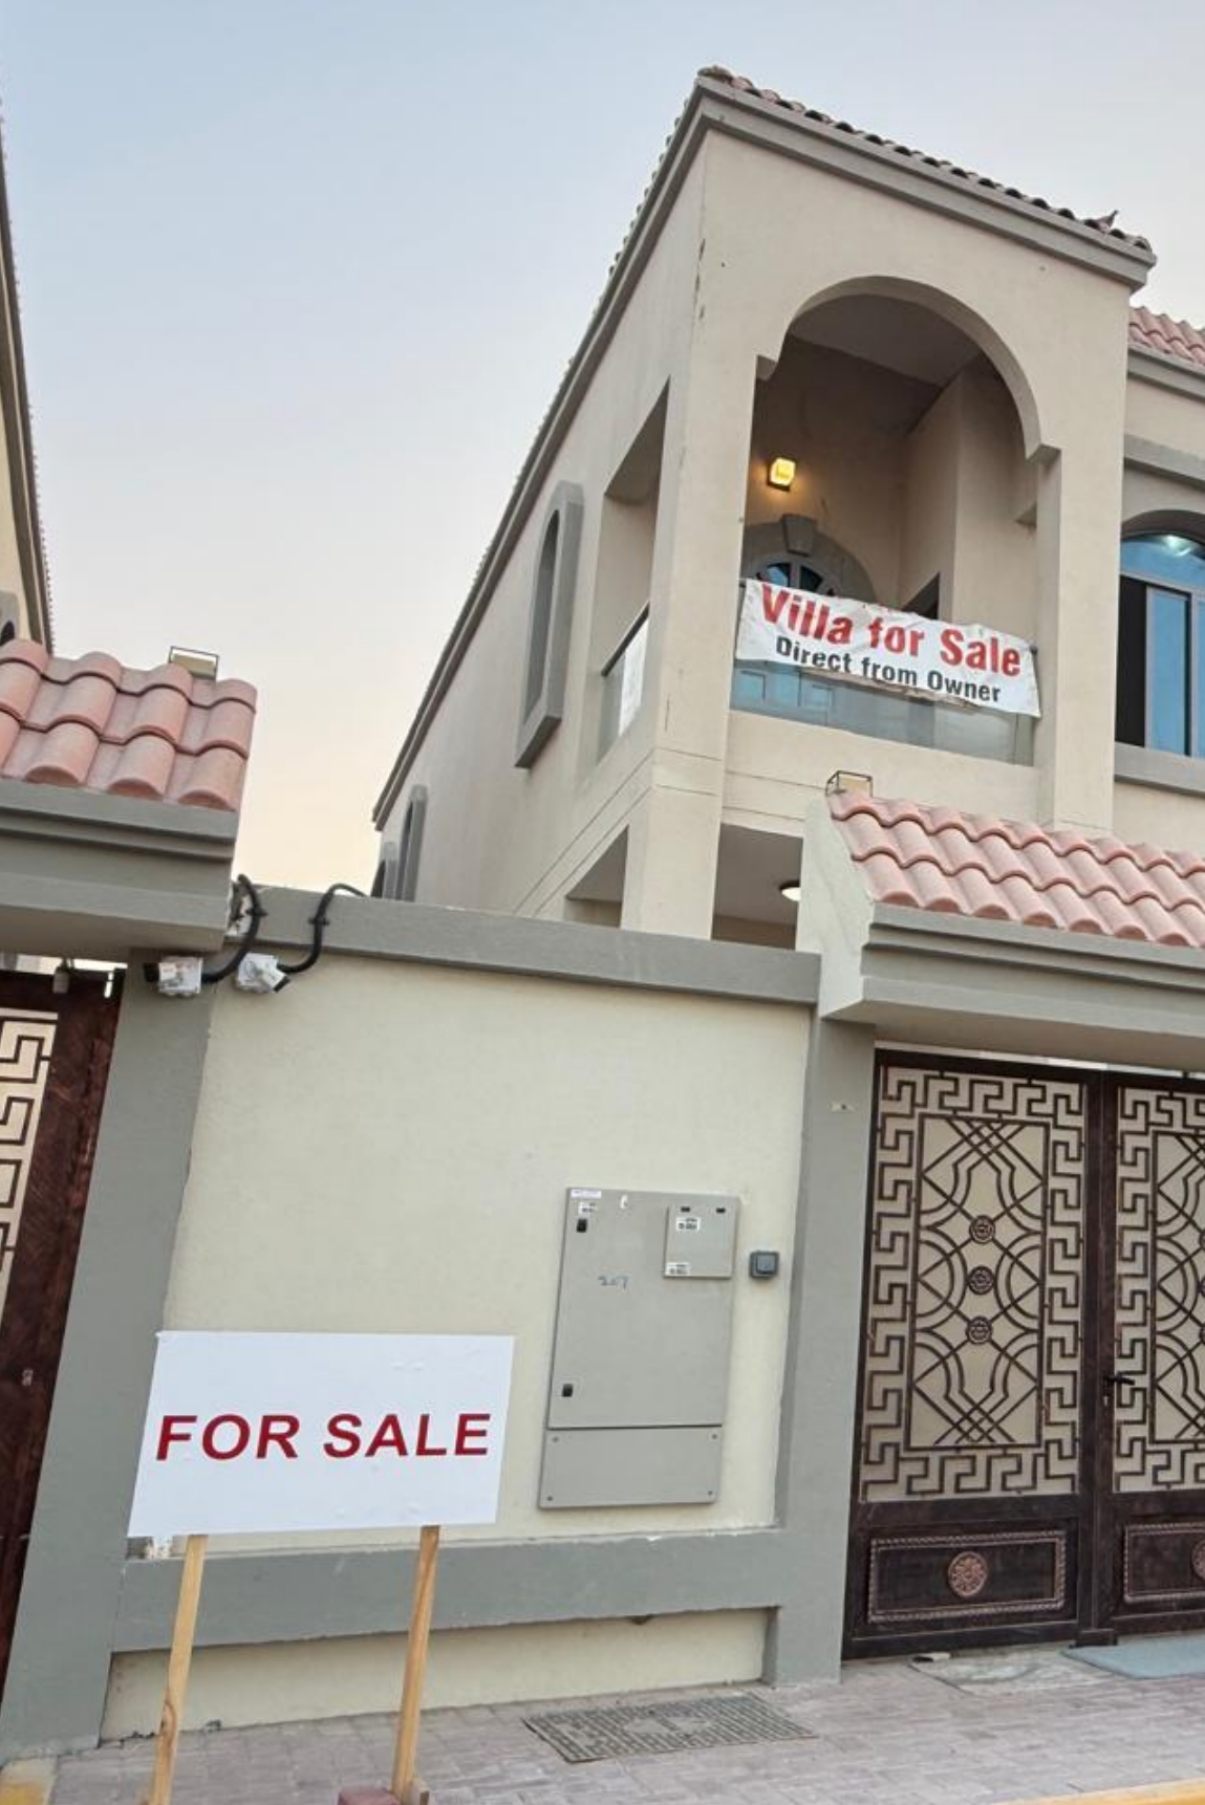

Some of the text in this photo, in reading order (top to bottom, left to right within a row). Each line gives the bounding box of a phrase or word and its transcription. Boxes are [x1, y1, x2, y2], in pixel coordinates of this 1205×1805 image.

[761, 583, 1021, 677] Villa for Sale
[775, 635, 1001, 702] Direct from Owner
[156, 1413, 491, 1461] FOR SALE
